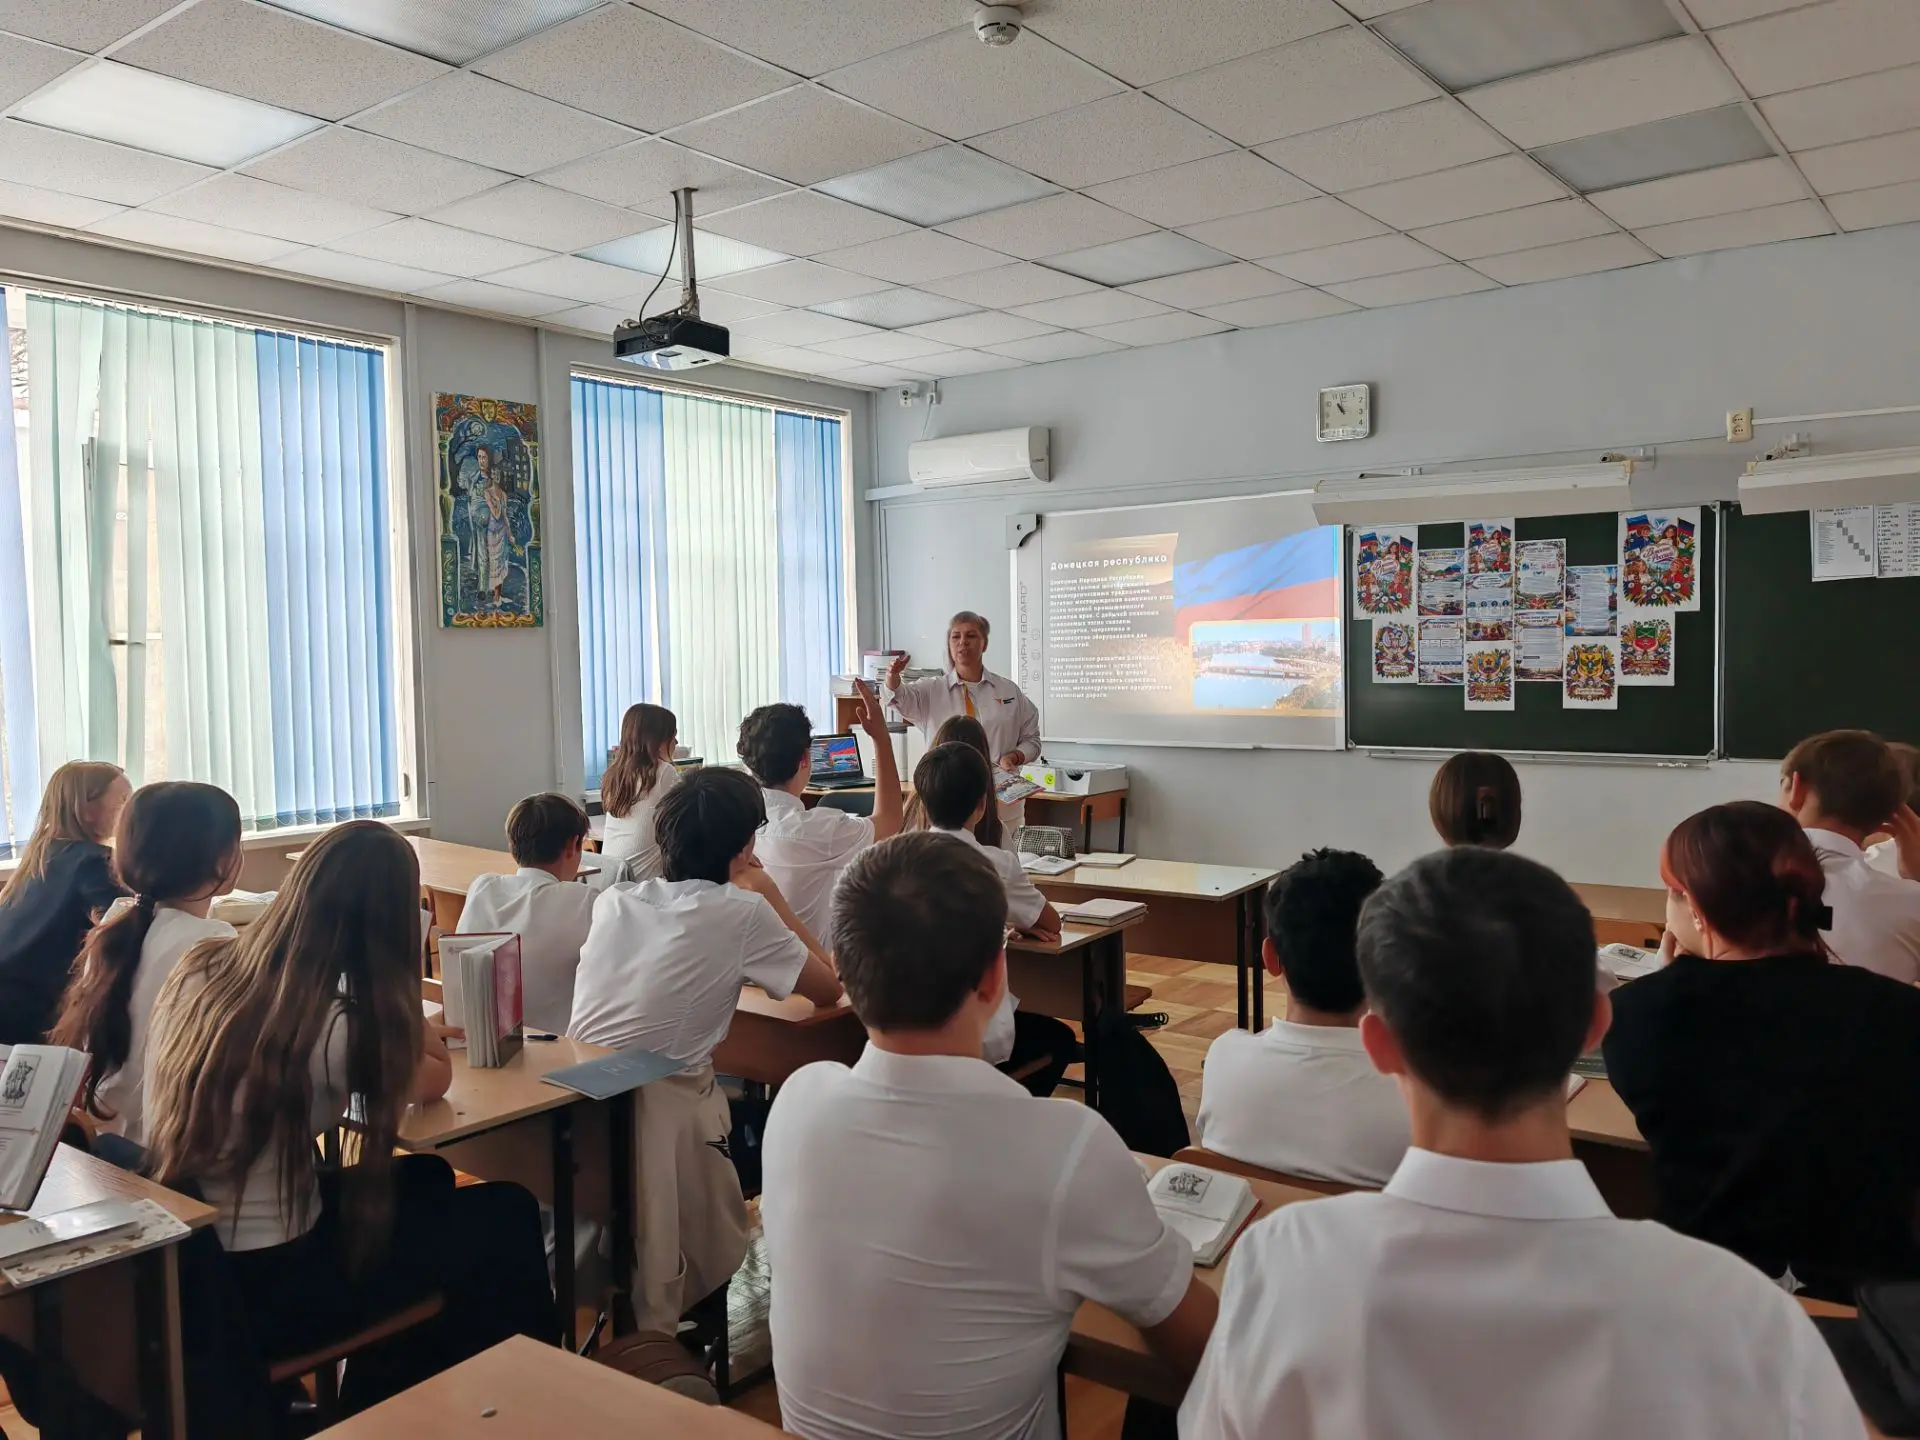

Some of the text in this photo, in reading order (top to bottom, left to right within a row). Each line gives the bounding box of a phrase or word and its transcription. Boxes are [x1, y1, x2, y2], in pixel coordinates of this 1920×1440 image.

[1050, 554, 1168, 571] Донецкая республика
[1020, 585, 1028, 634] BOARD
